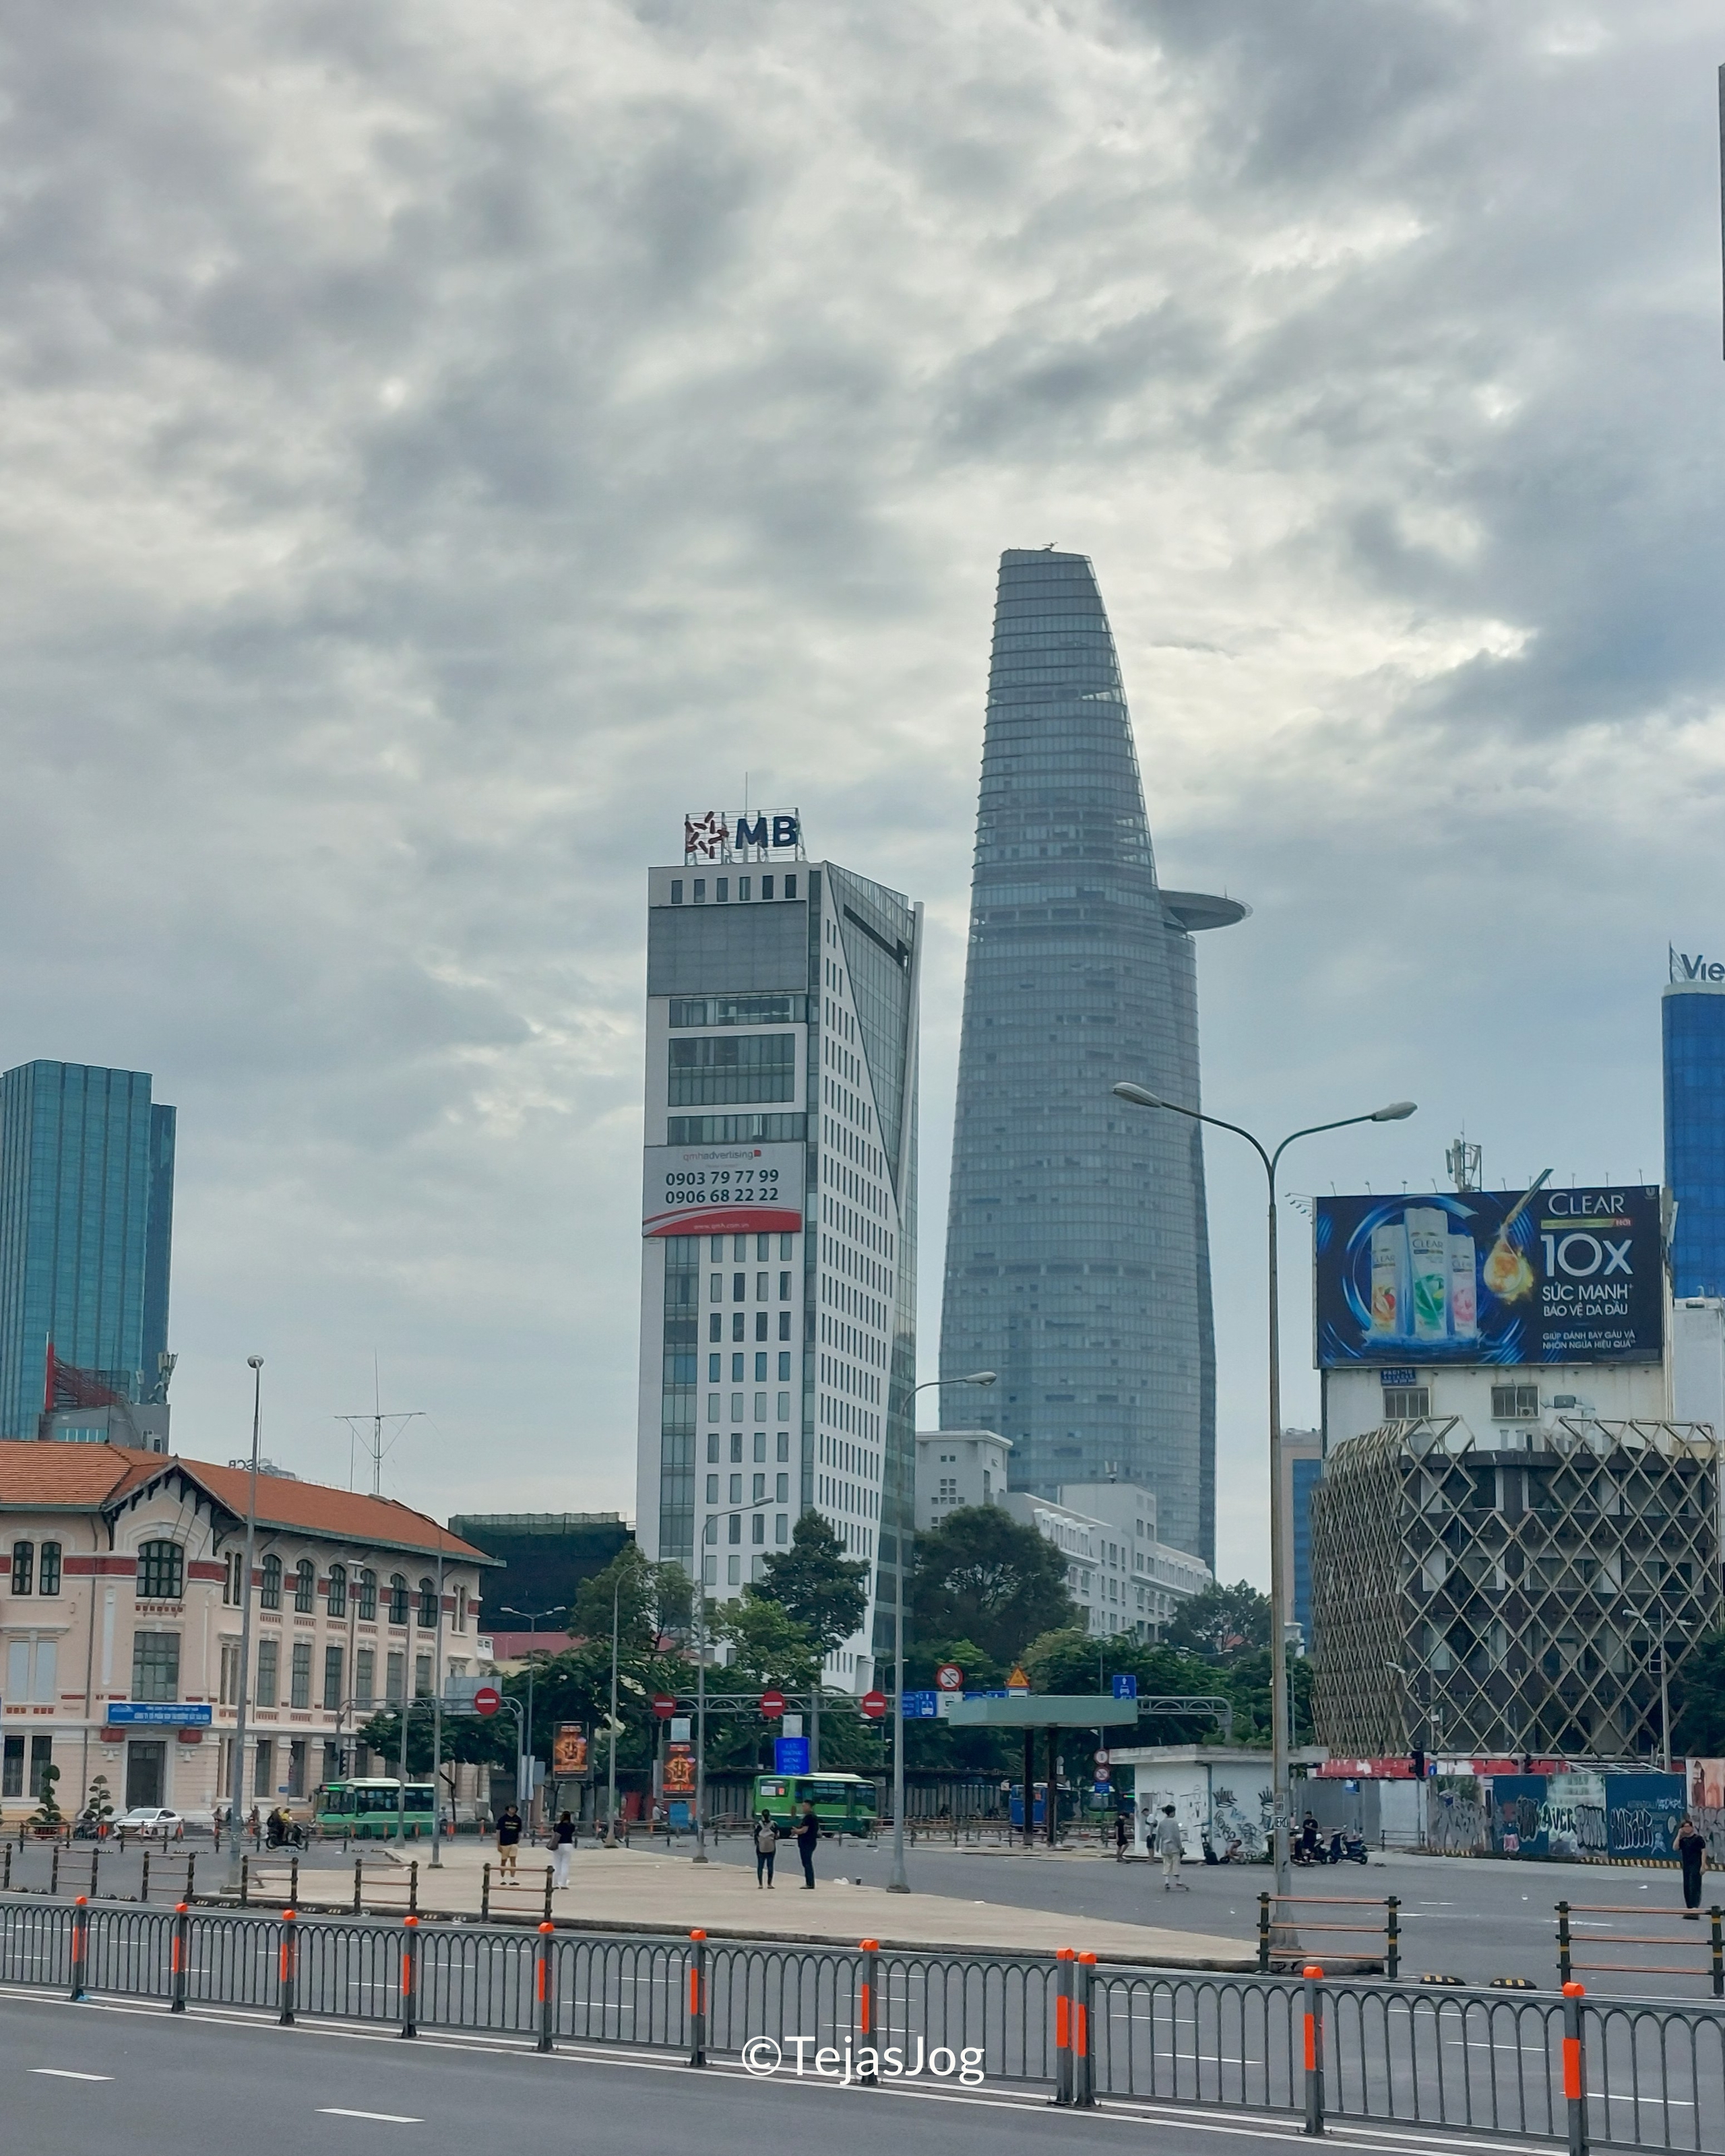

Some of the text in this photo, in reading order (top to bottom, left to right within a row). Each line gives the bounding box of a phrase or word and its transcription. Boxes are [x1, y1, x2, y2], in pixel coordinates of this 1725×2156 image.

[735, 816, 797, 850] MB
[683, 1149, 754, 1162] qmhadvertising
[666, 1169, 779, 1186] 0903 79 77 99
[665, 1188, 779, 1204] 0906 68 22 22
[1548, 1192, 1624, 1215] CLEAR
[1412, 1238, 1443, 1249] CLEAR
